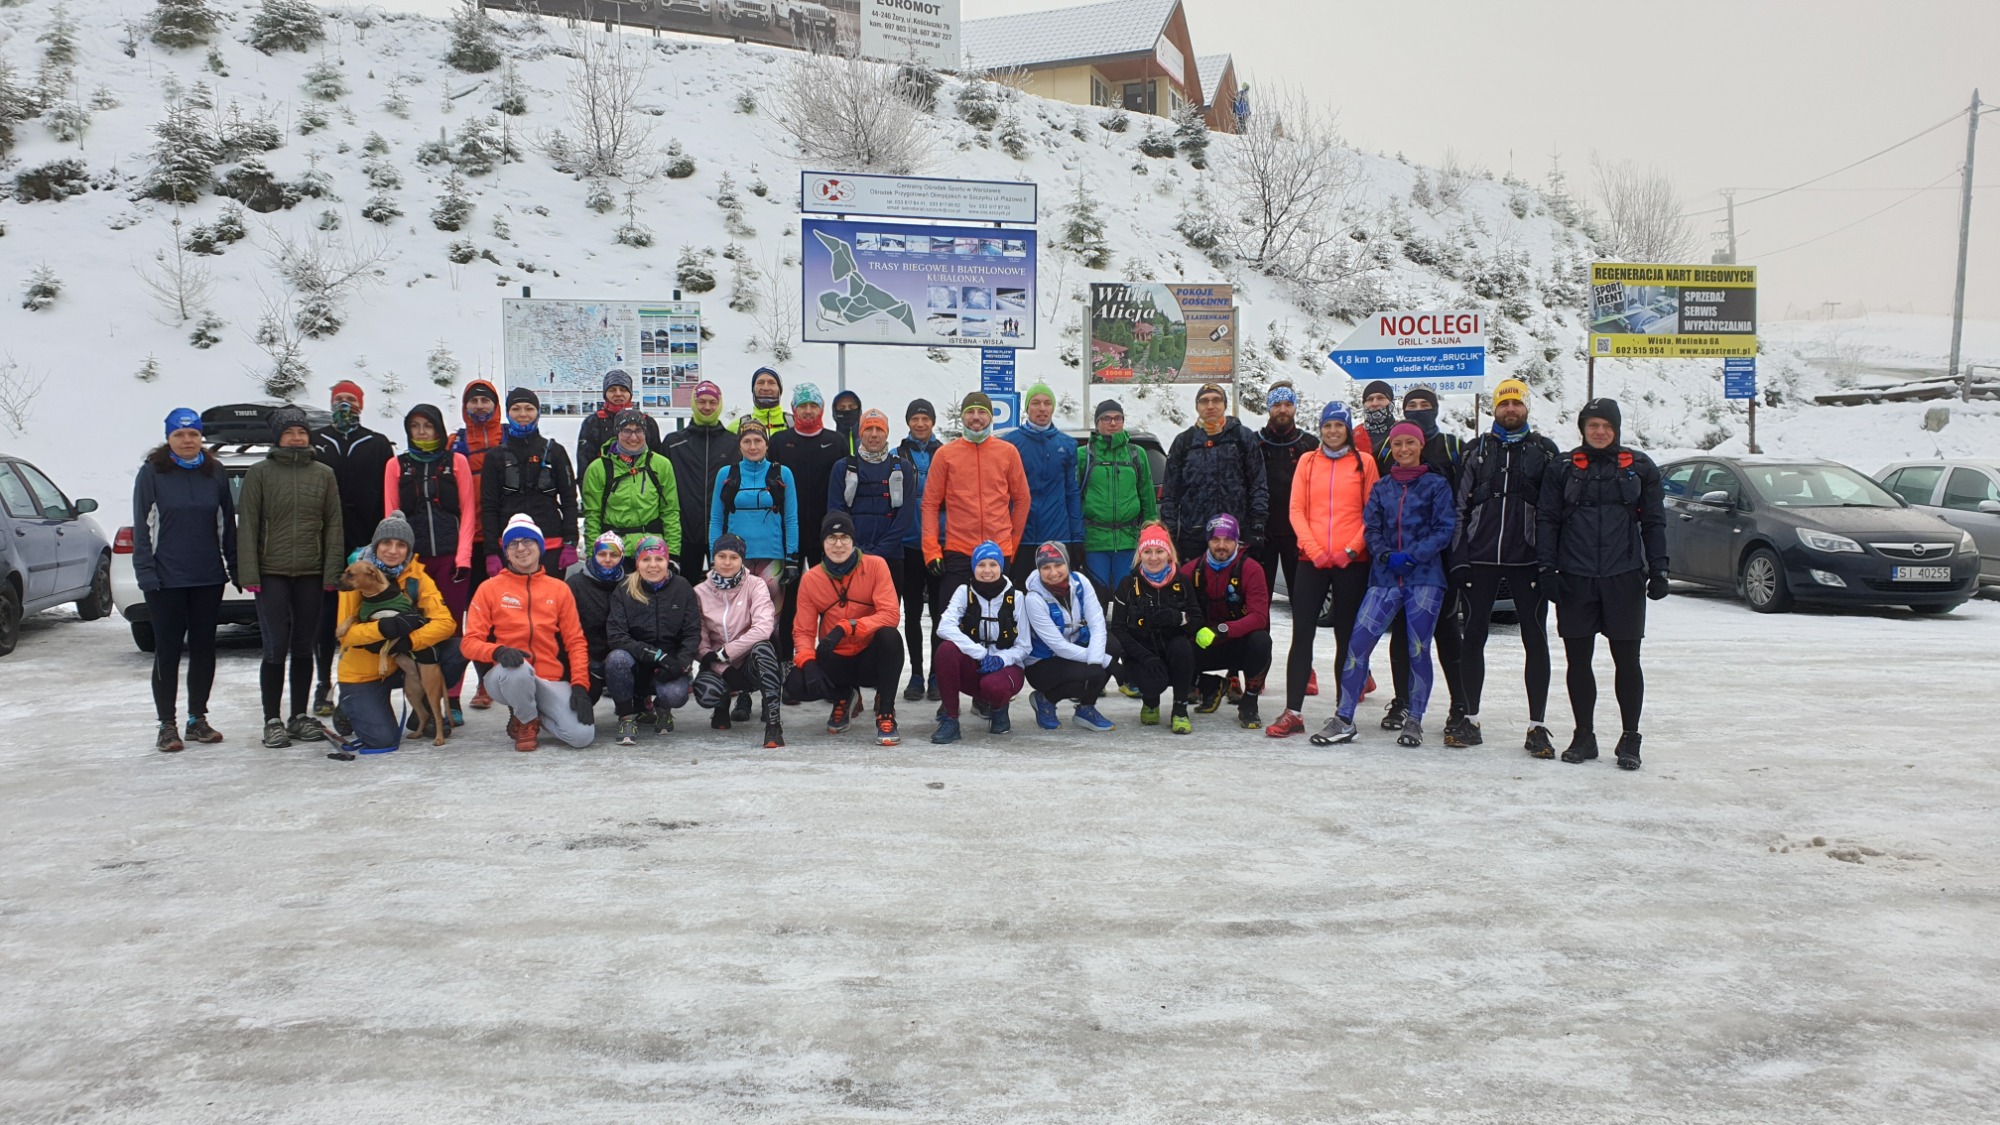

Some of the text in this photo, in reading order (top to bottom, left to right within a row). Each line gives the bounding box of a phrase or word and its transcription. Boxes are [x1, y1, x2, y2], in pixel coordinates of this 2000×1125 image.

[872, 10, 892, 20] 44-240
[870, 20, 884, 29] kom.
[868, 262, 899, 271] TRASY
[902, 263, 948, 273] BIEGOWE
[957, 265, 1026, 276] BIATHLONOWE
[1595, 268, 1753, 282] REGENERACJA NART BIEGOWYCH
[927, 274, 985, 283] KUBALONKA
[1595, 282, 1622, 296] SPORT
[1182, 296, 1230, 305] GOŚCINNE
[1597, 291, 1623, 306] RENT
[1684, 290, 1725, 302] SPRZEDAŻ
[1092, 304, 1155, 322] Alicja
[1684, 306, 1717, 316] SERWIS
[1380, 314, 1479, 336] NOCLEGI
[1684, 319, 1752, 332] WYPOŻYCZALNIA
[1338, 356, 1352, 366] 1,8
[1354, 355, 1368, 364] km
[1396, 354, 1436, 364] Wczasowy
[1423, 363, 1454, 371] Kozińce
[1440, 382, 1455, 390] 988
[1457, 382, 1472, 390] 407
[1900, 568, 1949, 579] SI 40255
